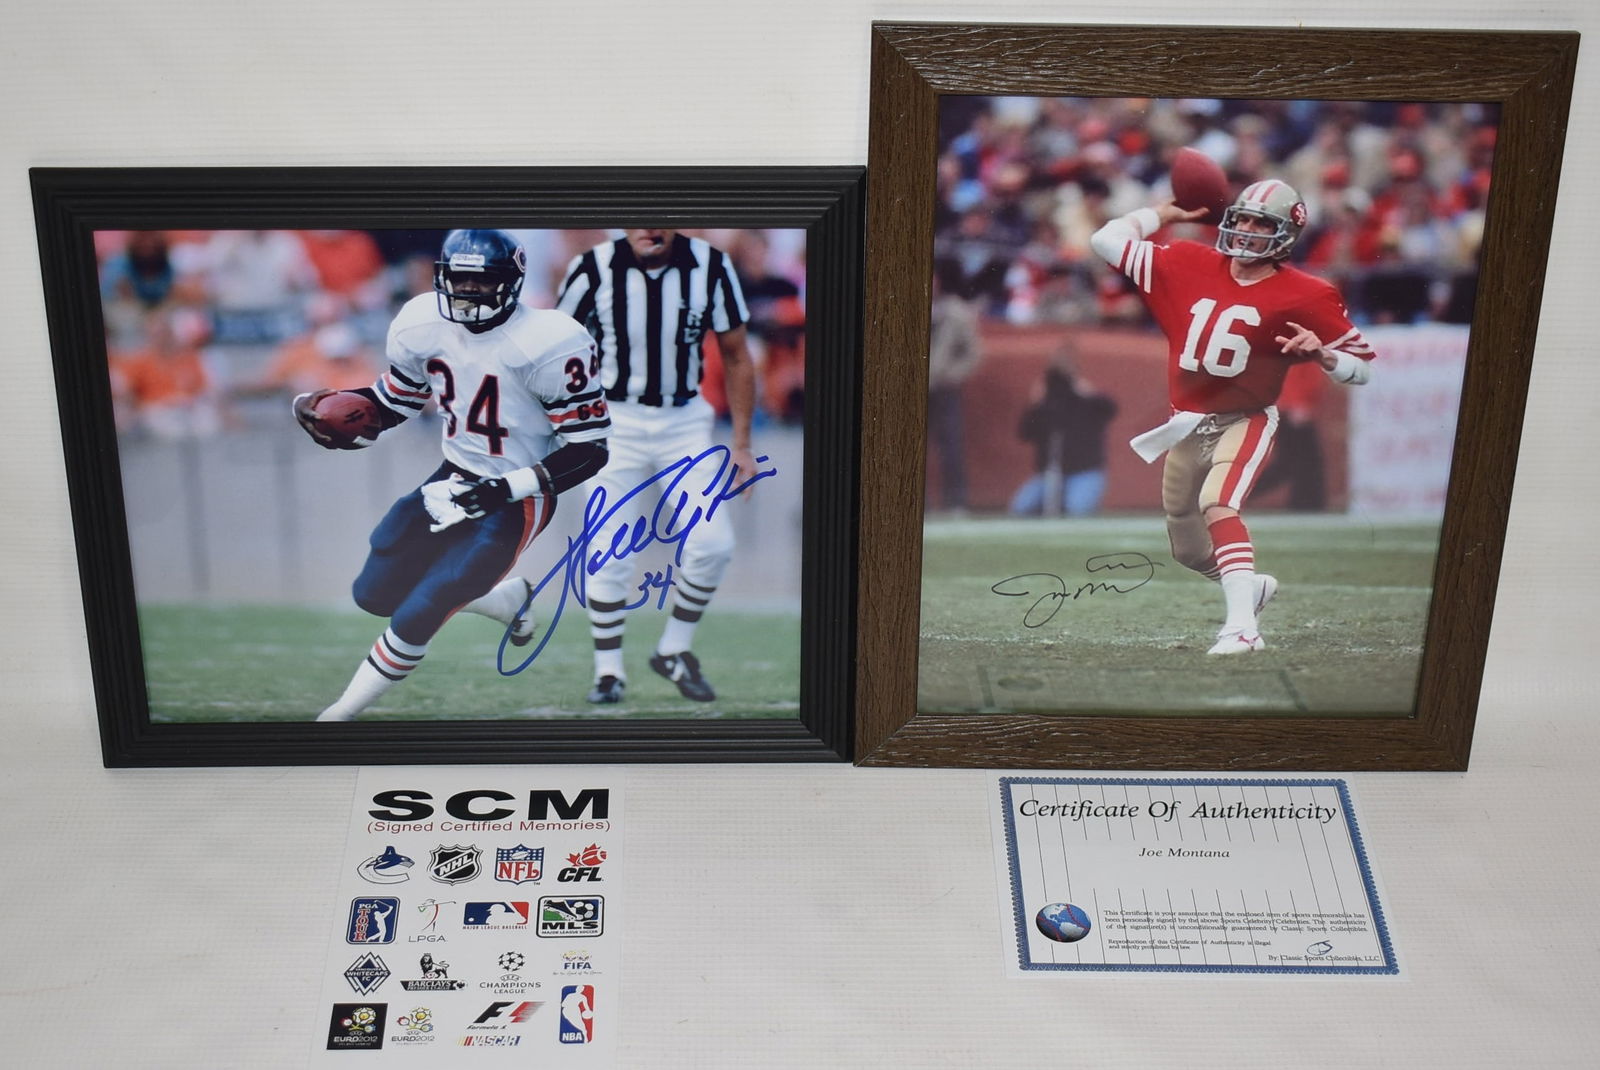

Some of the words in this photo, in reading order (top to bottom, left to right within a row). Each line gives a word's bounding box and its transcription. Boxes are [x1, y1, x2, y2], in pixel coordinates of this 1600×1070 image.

[1178, 297, 1261, 378] 16
[426, 357, 509, 456] 34
[622, 564, 676, 611] 34
[368, 788, 610, 822] SCM
[1019, 799, 1140, 822] Certificate
[1149, 800, 1182, 822] Of
[1190, 801, 1337, 824] Authenticity
[367, 821, 434, 834] (Signed
[440, 820, 513, 832] Certified
[519, 820, 611, 832] Memories)
[1139, 847, 1163, 857] Joe
[1168, 848, 1231, 858] Montana
[438, 854, 474, 878] NHL
[498, 861, 542, 882] NFL
[557, 866, 603, 883] CFL
[352, 908, 371, 942] TOUR
[541, 921, 599, 930] MLS
[408, 935, 447, 943] LPGA
[563, 962, 592, 970] FIFA
[471, 1035, 521, 1046] NASCAR
[562, 1032, 583, 1041] NBA
